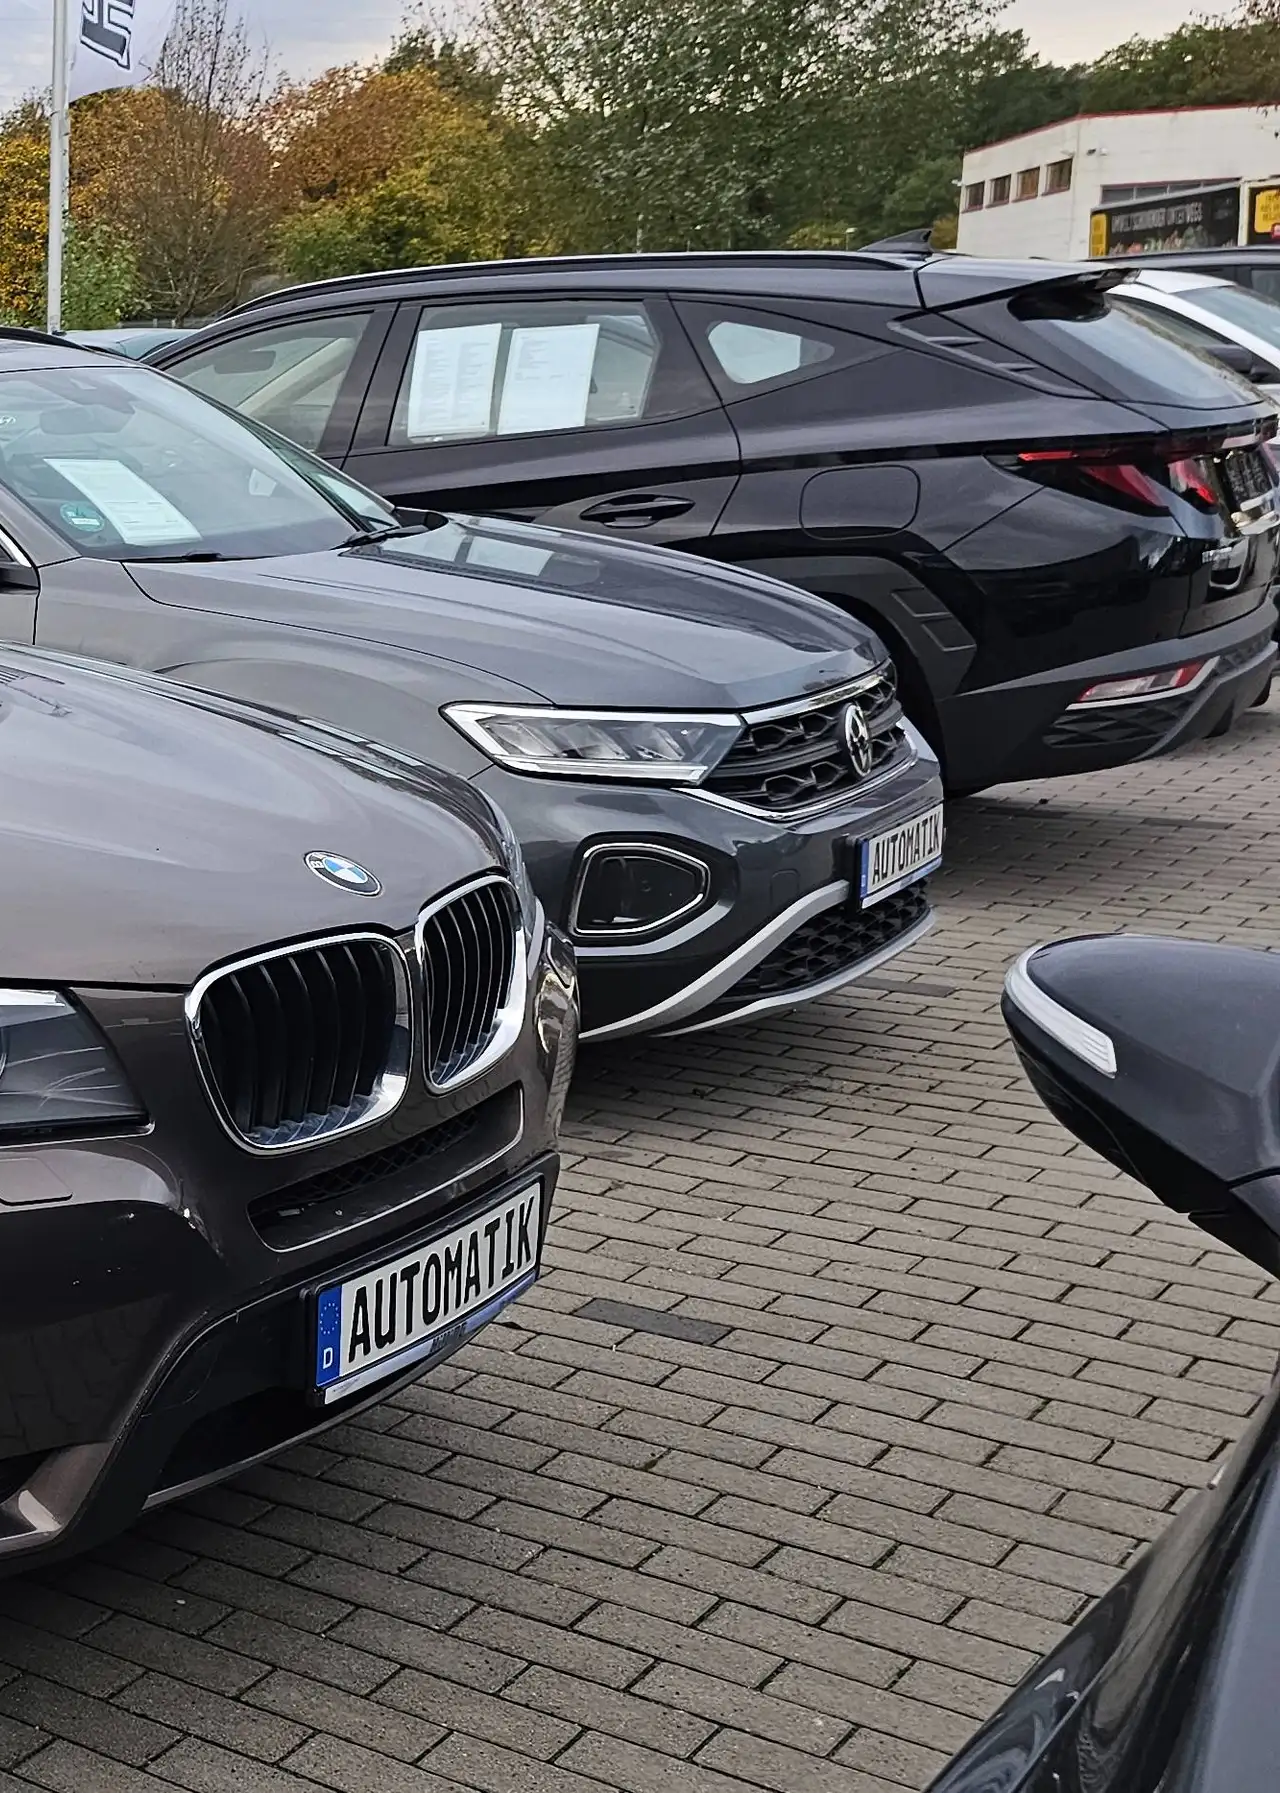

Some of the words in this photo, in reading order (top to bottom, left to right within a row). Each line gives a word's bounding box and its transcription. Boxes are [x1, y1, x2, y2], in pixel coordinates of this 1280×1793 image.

[872, 811, 940, 885] AUTOMATIK
[348, 1196, 535, 1363] AUTOMATIK
[322, 1347, 333, 1369] D
